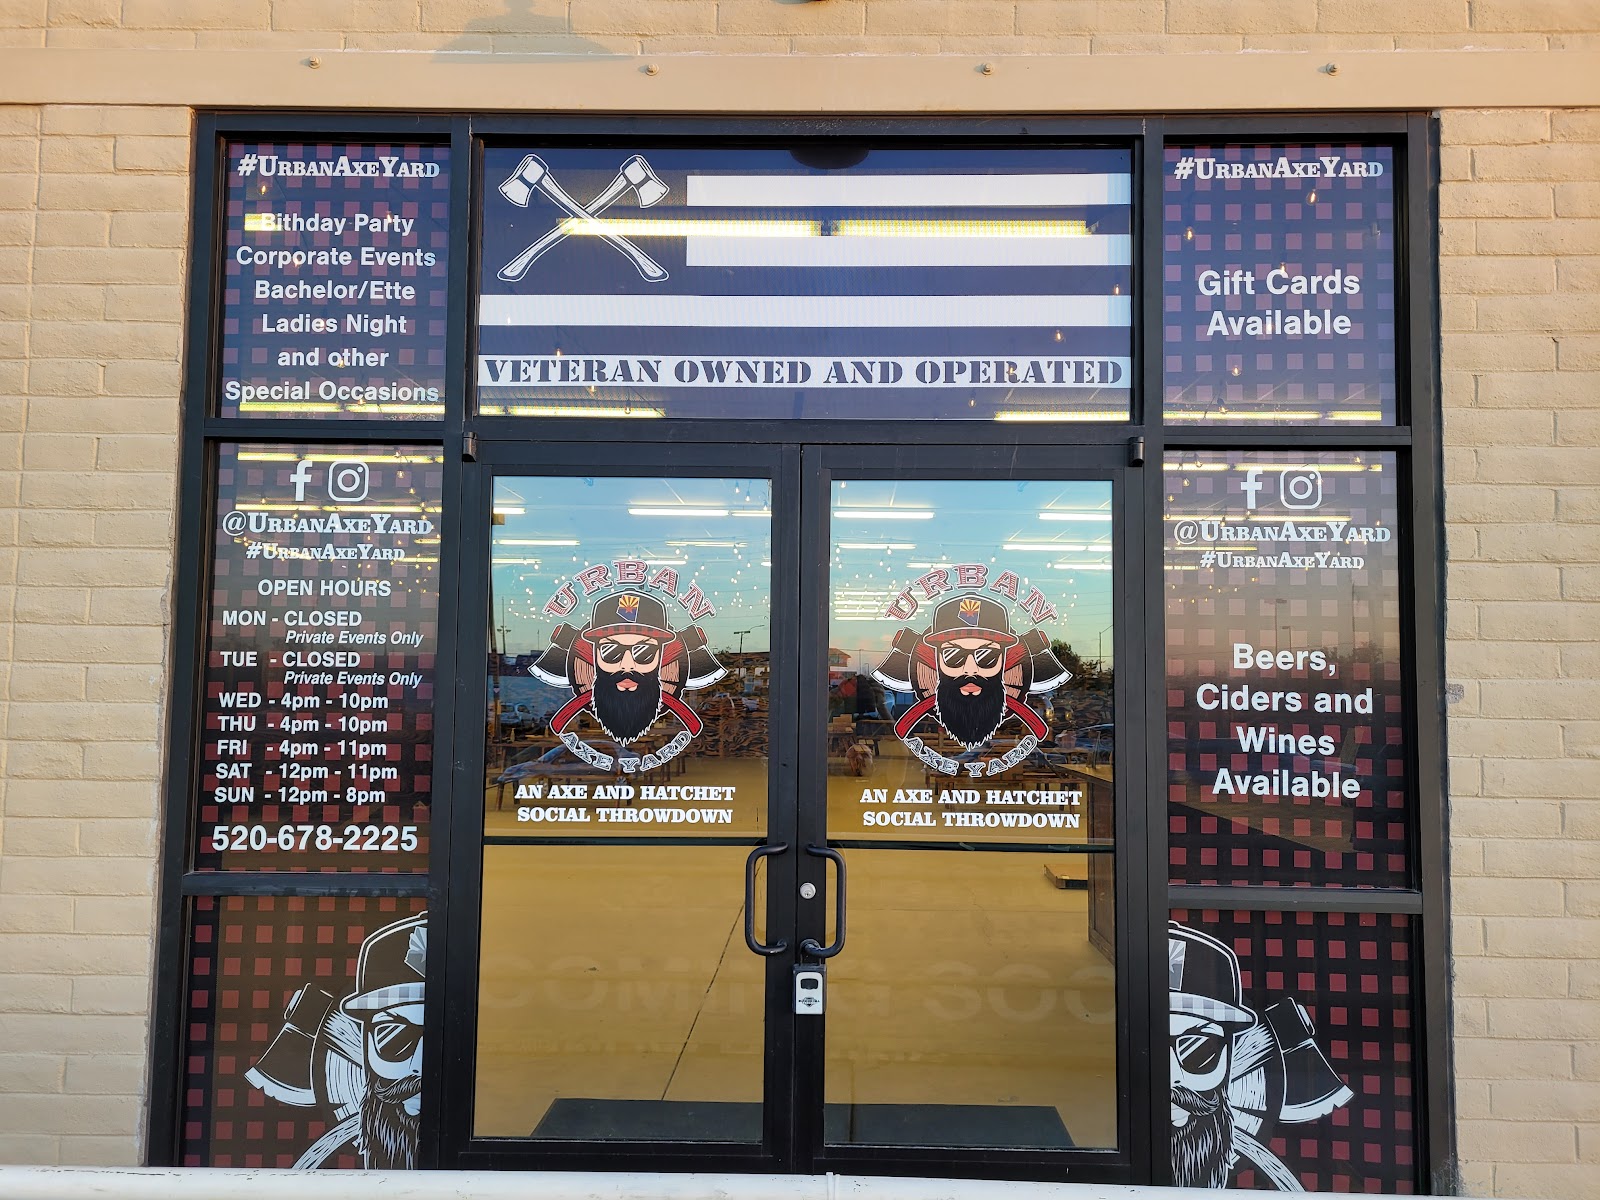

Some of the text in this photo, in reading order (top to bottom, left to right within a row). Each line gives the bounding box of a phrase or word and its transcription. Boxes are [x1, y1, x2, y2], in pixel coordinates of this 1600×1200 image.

[260, 213, 414, 236] Bithday Party
[236, 246, 436, 268] Corporate Events
[255, 280, 415, 300] Bachelor/Ette
[1198, 269, 1361, 296] Gift Cards
[262, 314, 407, 337] Ladies Night
[1206, 310, 1352, 336] Available
[277, 348, 389, 367] and other
[485, 358, 1123, 385] VETERAN OWNED AND OPERATED
[225, 381, 439, 403] Special Occasions
[258, 579, 392, 597] OPEN HOURS
[542, 559, 717, 622] URBAN
[884, 563, 1058, 625] URBAN
[222, 610, 266, 626] MON
[284, 611, 362, 626] CLOSED
[285, 630, 424, 648] Private Events Only
[220, 651, 258, 667] TUE
[282, 651, 361, 667] CLOSED
[1233, 643, 1337, 677] Beers,
[284, 671, 423, 688] Private Events Only
[218, 692, 262, 708] WED
[281, 692, 320, 711] 4pm
[338, 692, 389, 711] 10pm
[1196, 683, 1373, 714] Ciders and
[217, 716, 256, 731] THU
[280, 716, 319, 734] 4pm
[338, 716, 388, 735] 10pm
[217, 739, 248, 755] FRI
[278, 739, 318, 758] 4pm
[337, 739, 387, 759] 11pm
[560, 730, 692, 773] AXE YARD
[1236, 726, 1335, 756] Wines
[904, 734, 1038, 777] AXE YARD
[215, 763, 252, 779] SAT
[278, 763, 329, 782] 12pm
[347, 763, 398, 783] 11pm
[1212, 767, 1361, 799] Available
[214, 787, 255, 803] SUN
[277, 787, 328, 806] 12pm
[346, 787, 386, 806] 8pm
[515, 785, 735, 801] AN AXE AND HATCHET
[860, 789, 1082, 806] AN AXE AND HATCHET
[518, 807, 733, 824] SOCIAL THROWDOWN
[863, 811, 1080, 828] SOCIAL THROWDOWN
[211, 825, 418, 852] 520-678-2225
